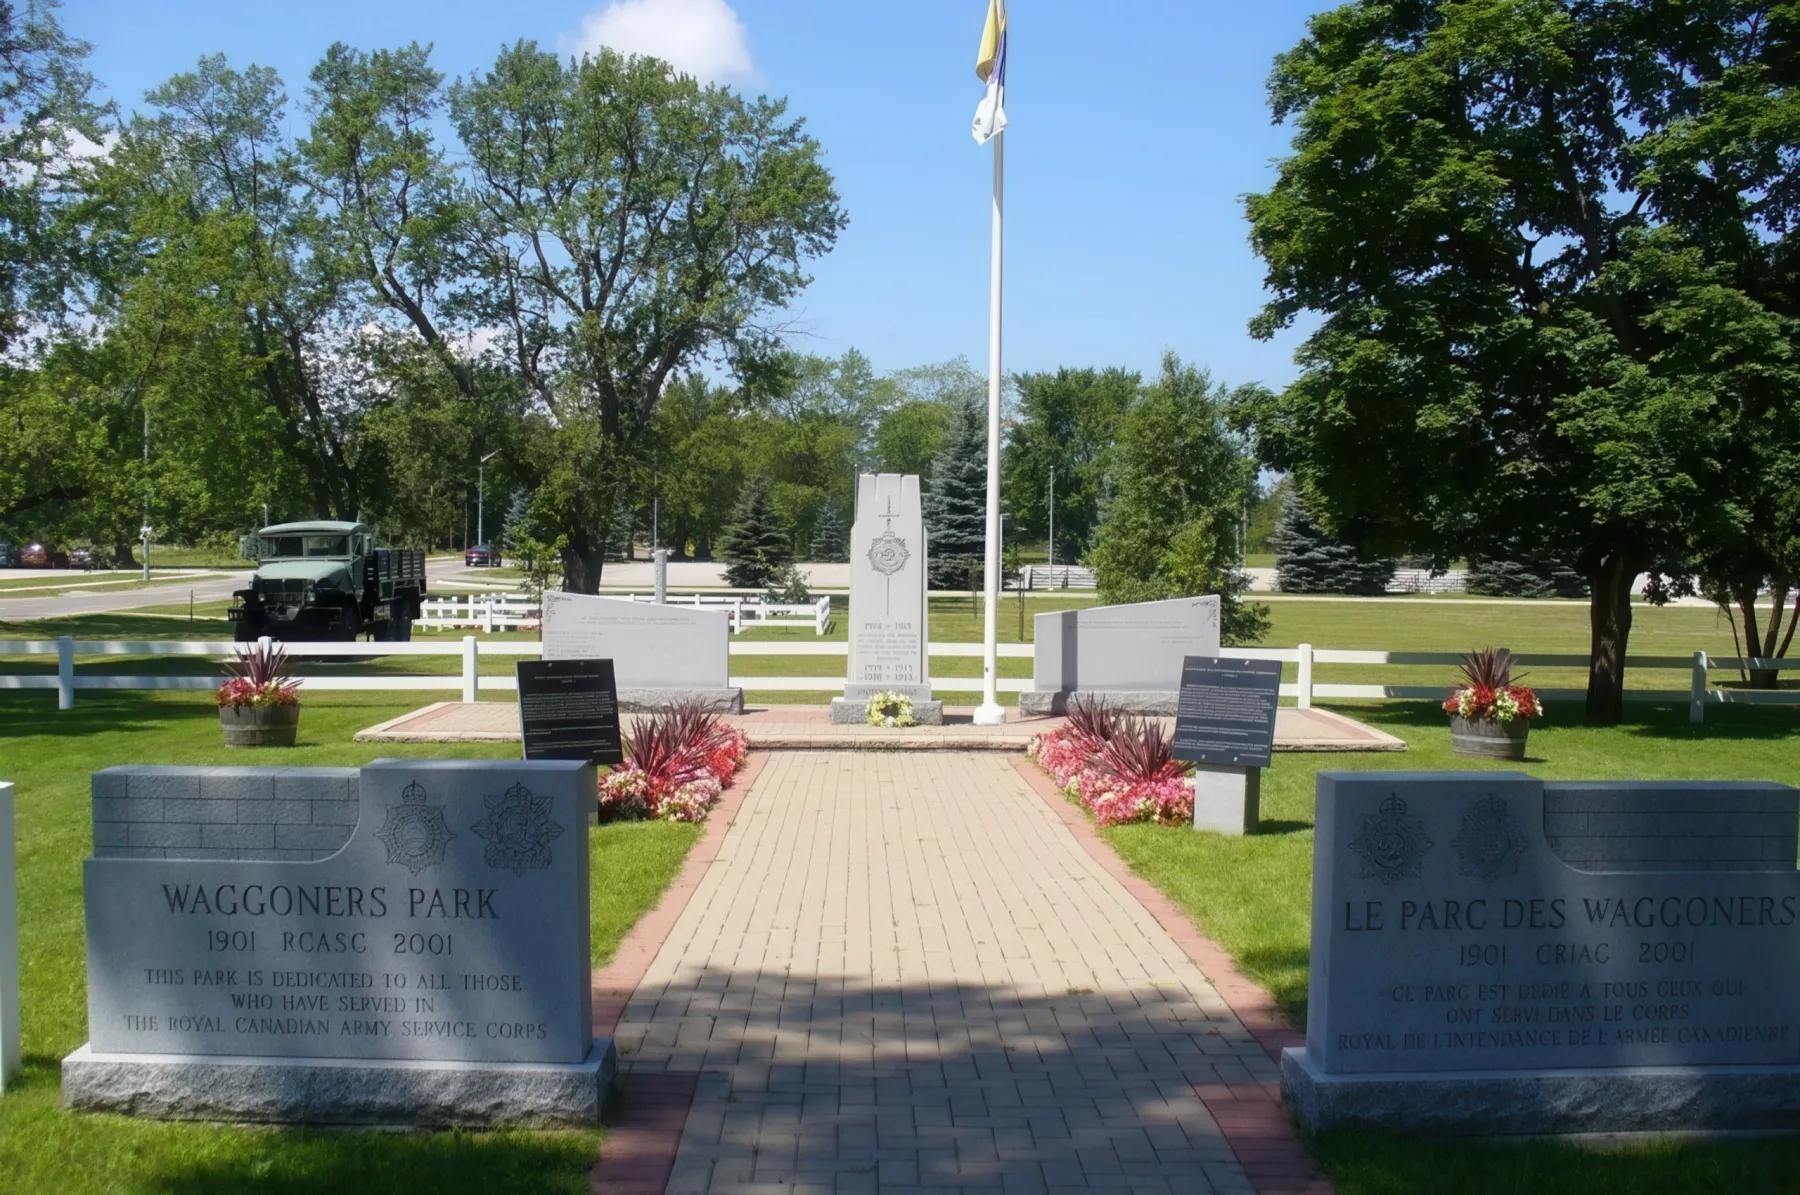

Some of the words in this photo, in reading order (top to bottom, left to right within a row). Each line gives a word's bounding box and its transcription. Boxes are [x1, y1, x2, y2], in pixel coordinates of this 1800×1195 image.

[160, 884, 387, 918] WAGGONERS
[408, 887, 500, 919] PARK
[1343, 900, 1384, 931] LE
[1400, 899, 1487, 931] PARC
[1502, 898, 1566, 930] DES
[1583, 896, 1796, 928] WAGGONERS
[208, 930, 255, 952] 1901
[283, 931, 367, 954] RCASC
[394, 933, 453, 956] 2001
[1460, 944, 1506, 967] 1901
[1536, 943, 1610, 965] CRIAC
[1638, 941, 1694, 963] 2001
[143, 968, 184, 986] THIS
[193, 969, 238, 986] PARK
[247, 970, 263, 987] IS
[272, 971, 373, 989] DEDICATED
[382, 973, 407, 989] TO
[416, 974, 451, 990] ALL
[461, 974, 523, 991] THOSE
[1424, 985, 1470, 1001] PARC
[1478, 984, 1509, 1000] EST
[1602, 981, 1649, 999] TOUS
[1657, 980, 1702, 997] CEUX
[231, 993, 273, 1010] WHO
[282, 994, 329, 1012] HAVE
[338, 996, 406, 1013] SERVED
[415, 997, 434, 1013] IN
[1446, 1008, 1483, 1025] ONT
[1491, 1006, 1539, 1024] SERVI
[1548, 1005, 1595, 1022] DANS
[1604, 1005, 1623, 1022] LE
[1632, 1004, 1690, 1021] CORPS
[123, 1014, 159, 1032] THE
[168, 1015, 226, 1033] ROYAL
[235, 1017, 330, 1035] CANADIAN
[340, 1020, 392, 1036] ARMY
[401, 1021, 477, 1038] SERVICE
[486, 1022, 547, 1040] CORPS
[1338, 1033, 1396, 1050] ROYAL
[1404, 1032, 1426, 1049] DE
[1569, 1029, 1591, 1046] DE
[1677, 1025, 1790, 1044] CANADIENNE
